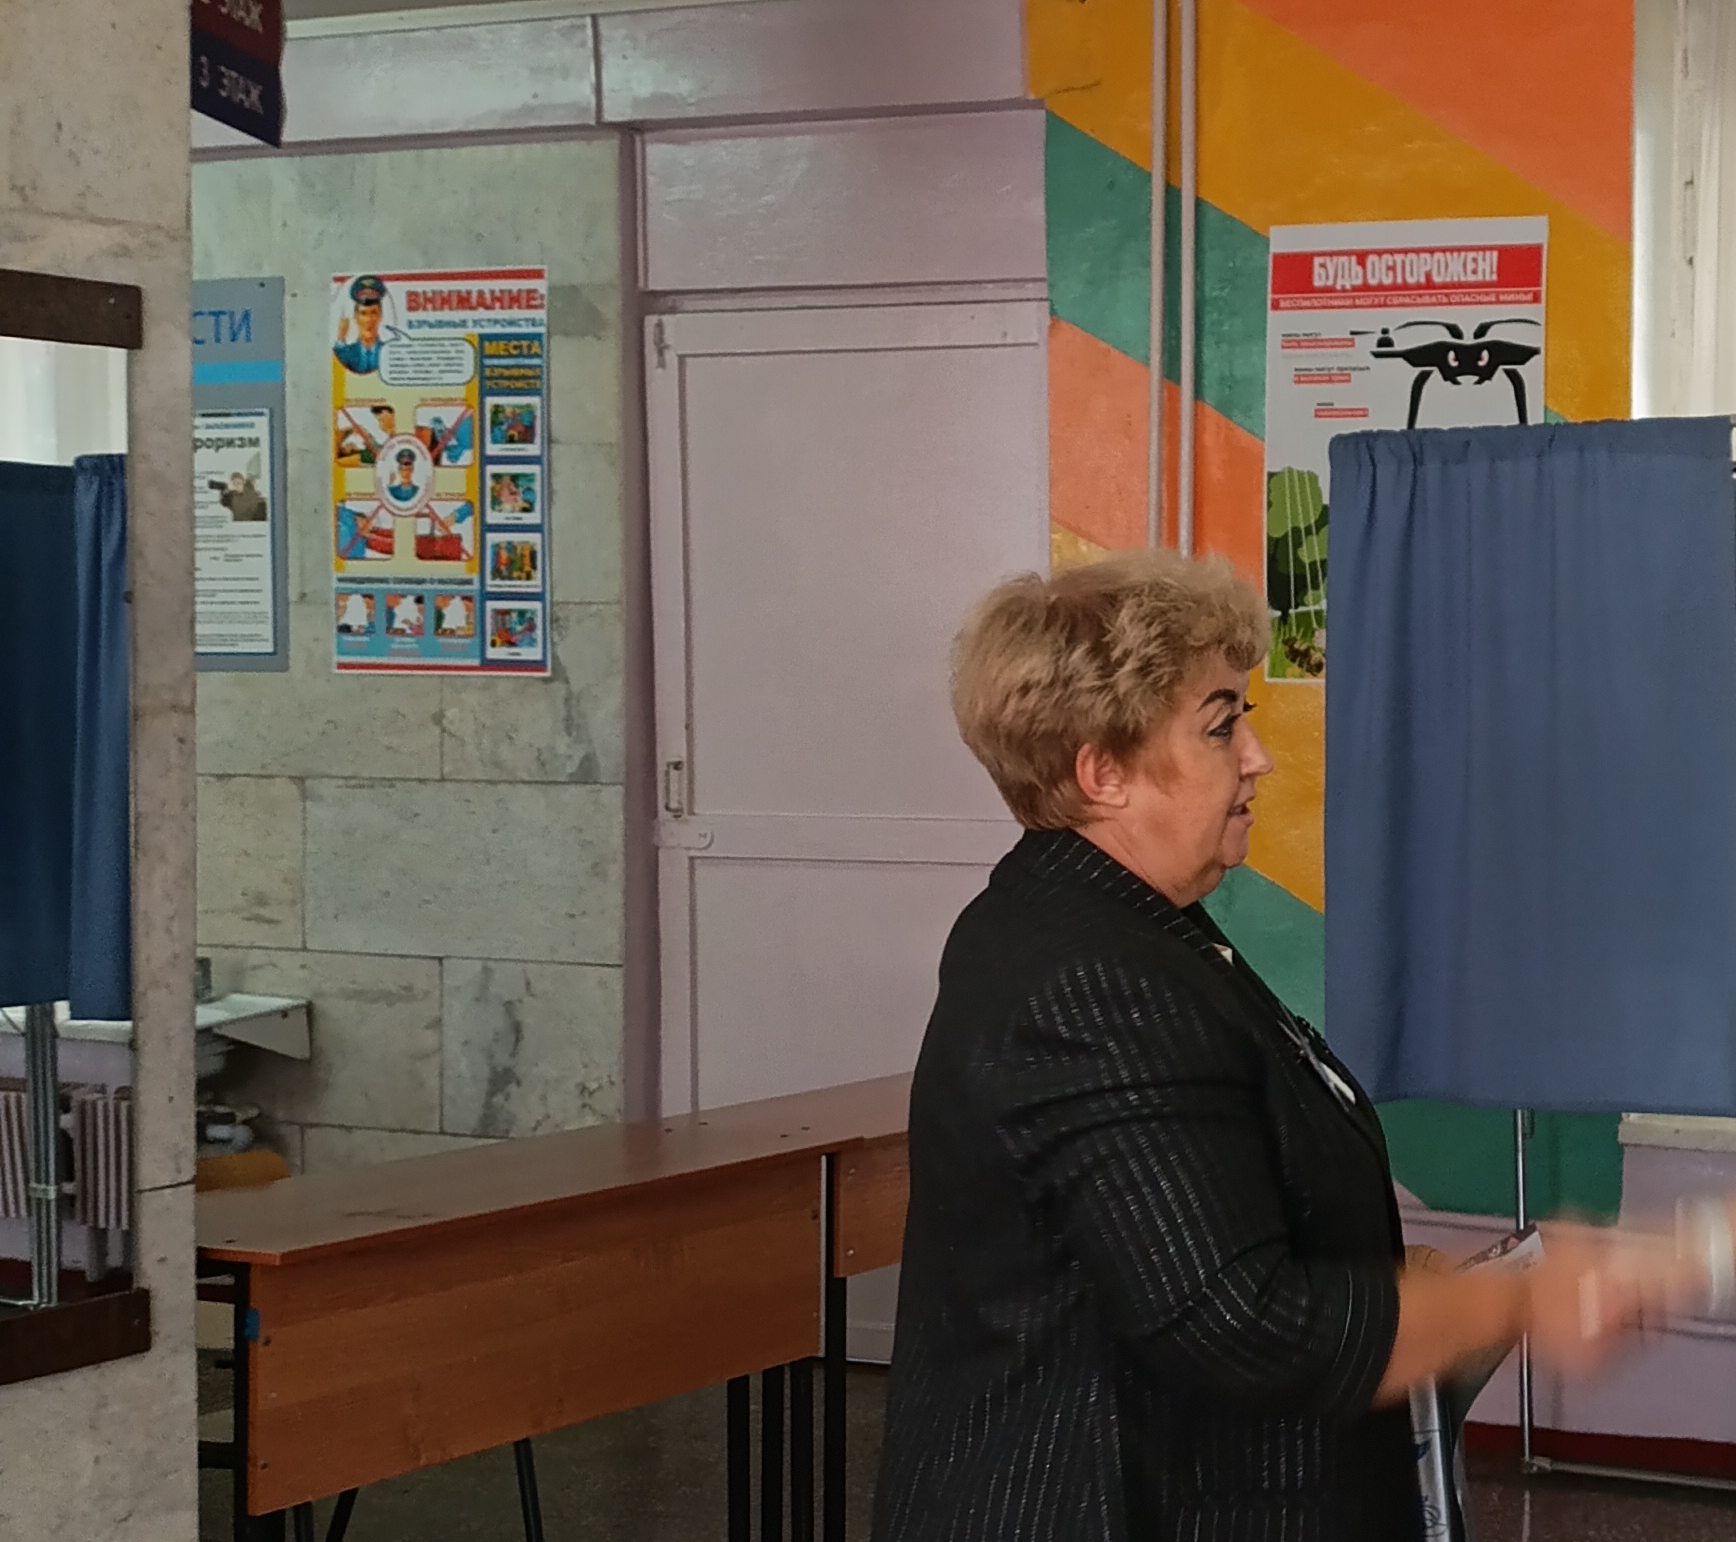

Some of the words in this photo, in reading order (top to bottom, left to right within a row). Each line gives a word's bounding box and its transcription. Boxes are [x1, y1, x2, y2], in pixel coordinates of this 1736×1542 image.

[200, 55, 210, 88] 3
[217, 64, 264, 115] ЭТАЖ
[1312, 255, 1363, 290] БУДЬ
[1366, 250, 1498, 286] ОСТОРОЖЕН!
[1354, 296, 1385, 307] МОГУТ
[1386, 294, 1449, 305] СБРАСЫВАТЬ
[1449, 292, 1497, 303] ОПАСНЫЕ
[484, 339, 542, 356] МЕСТА
